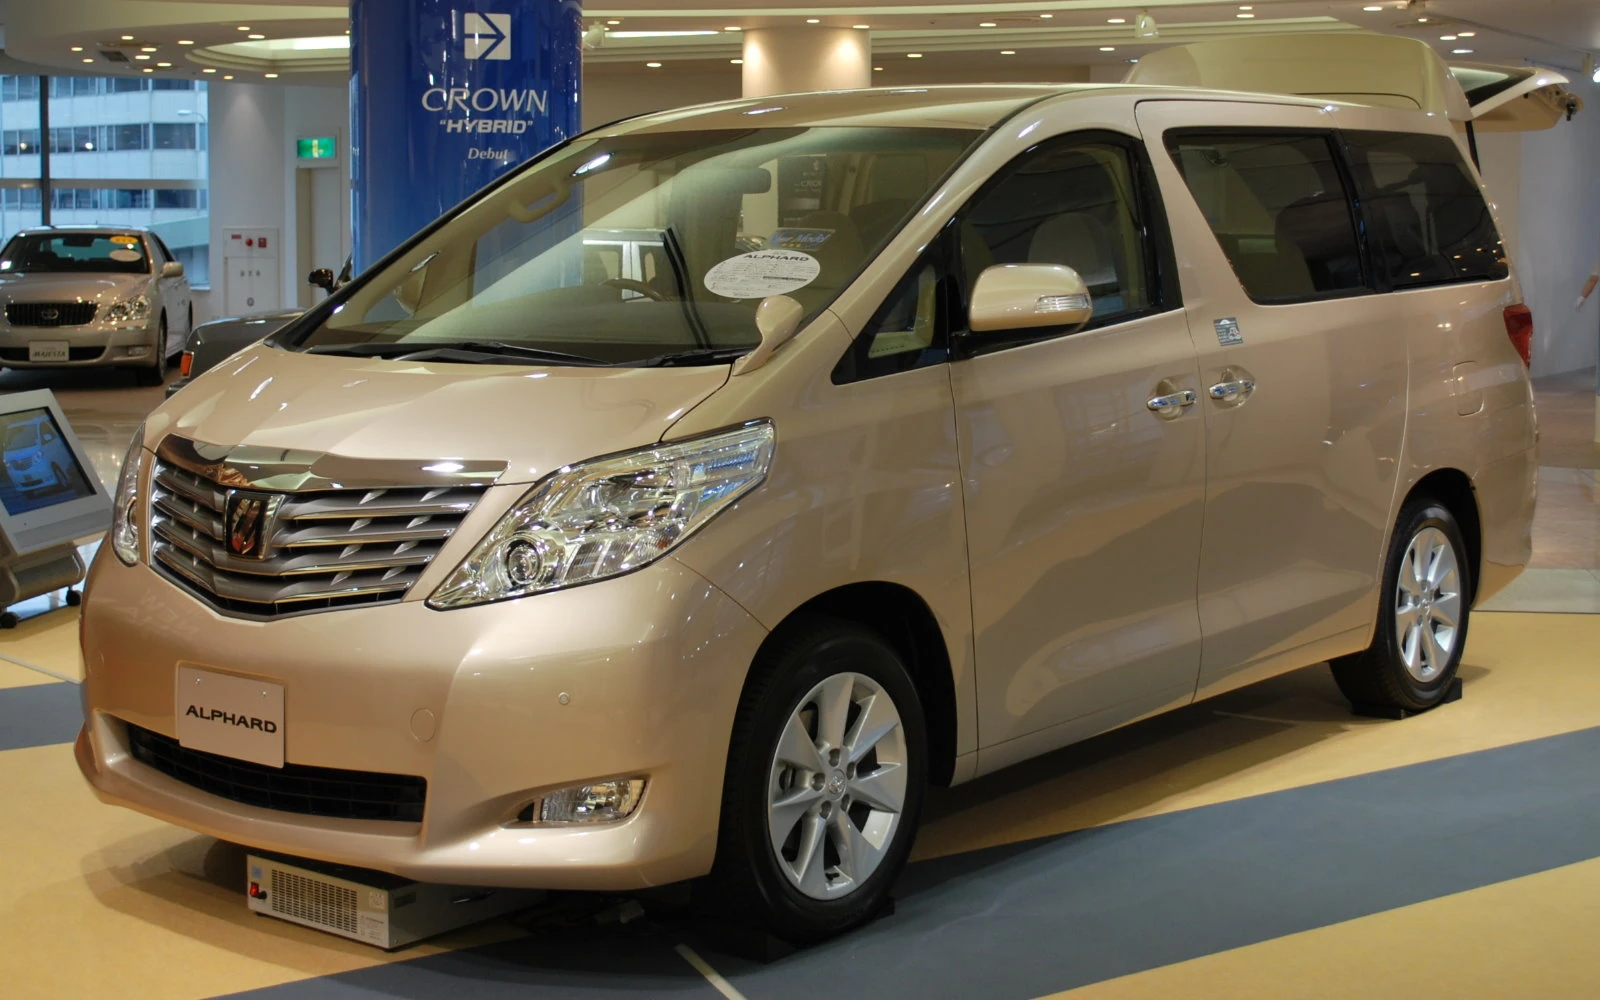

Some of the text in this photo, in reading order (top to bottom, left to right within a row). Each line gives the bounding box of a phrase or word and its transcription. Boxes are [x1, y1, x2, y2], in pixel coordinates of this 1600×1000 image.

[421, 87, 548, 113] CROWN
[467, 147, 509, 160] Debut
[744, 254, 809, 262] ALPHARD
[185, 704, 277, 734] ALPHARD
